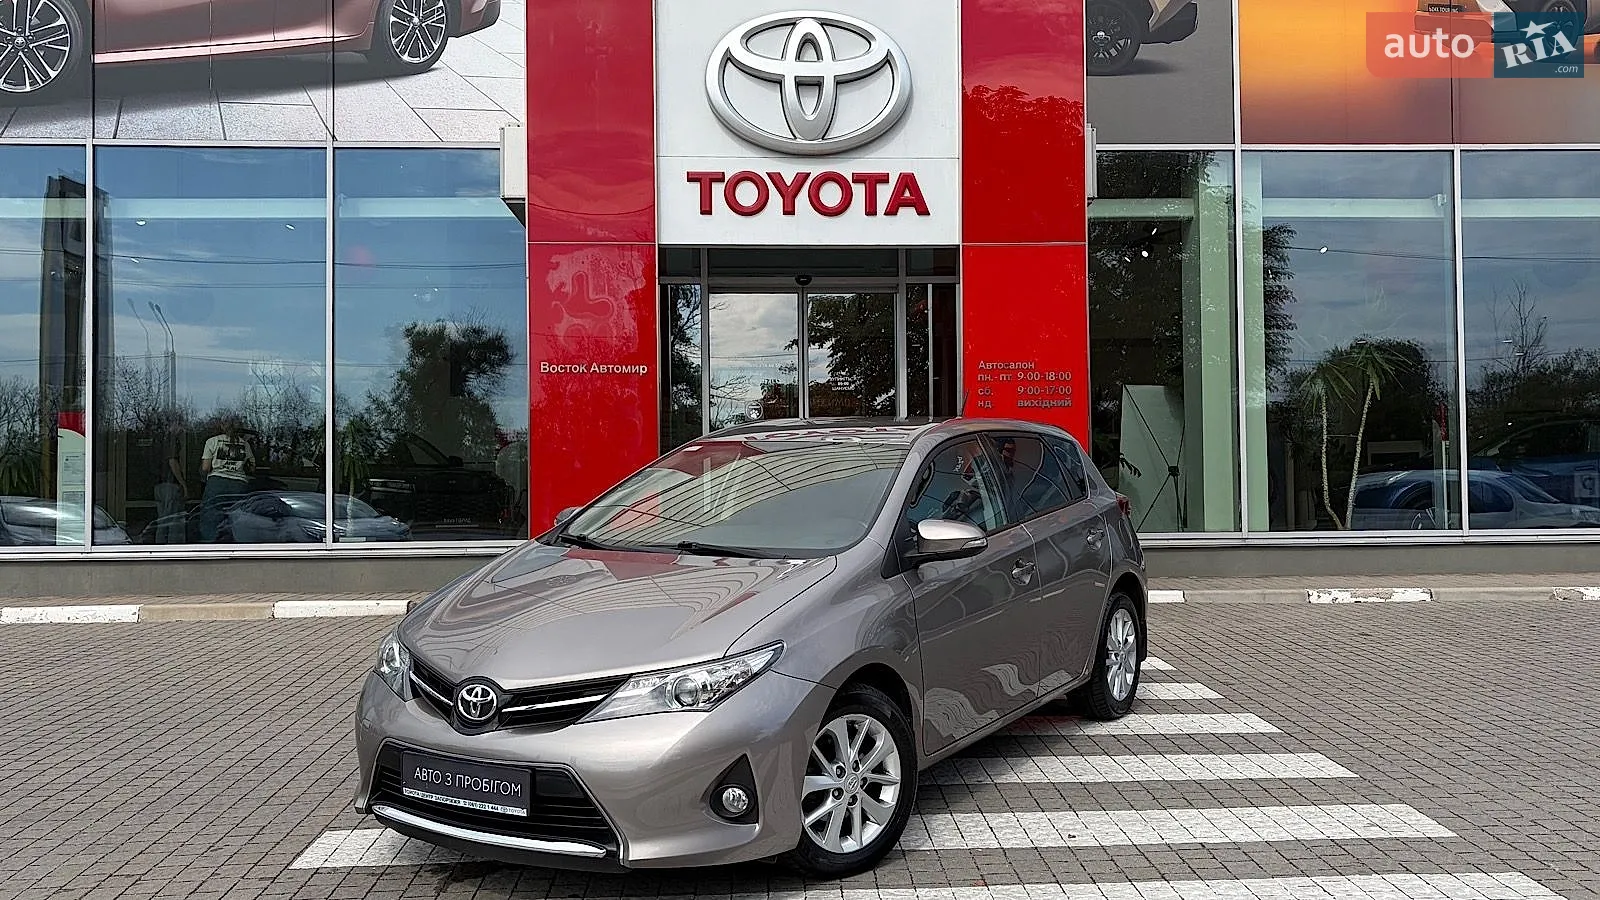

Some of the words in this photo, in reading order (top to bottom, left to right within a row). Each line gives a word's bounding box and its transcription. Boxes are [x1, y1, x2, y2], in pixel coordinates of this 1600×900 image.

[686, 170, 931, 217] TOYOTA
[540, 362, 587, 373] Восток
[590, 362, 648, 376] Автомир
[978, 360, 1035, 370] Автосалон
[977, 386, 994, 395] сб.
[1017, 385, 1072, 395] 9:00-17:00
[1017, 397, 1072, 408] вихідний
[414, 767, 442, 784] АВТО
[444, 773, 452, 786] З
[455, 774, 521, 797] ПРОБІГОМ
